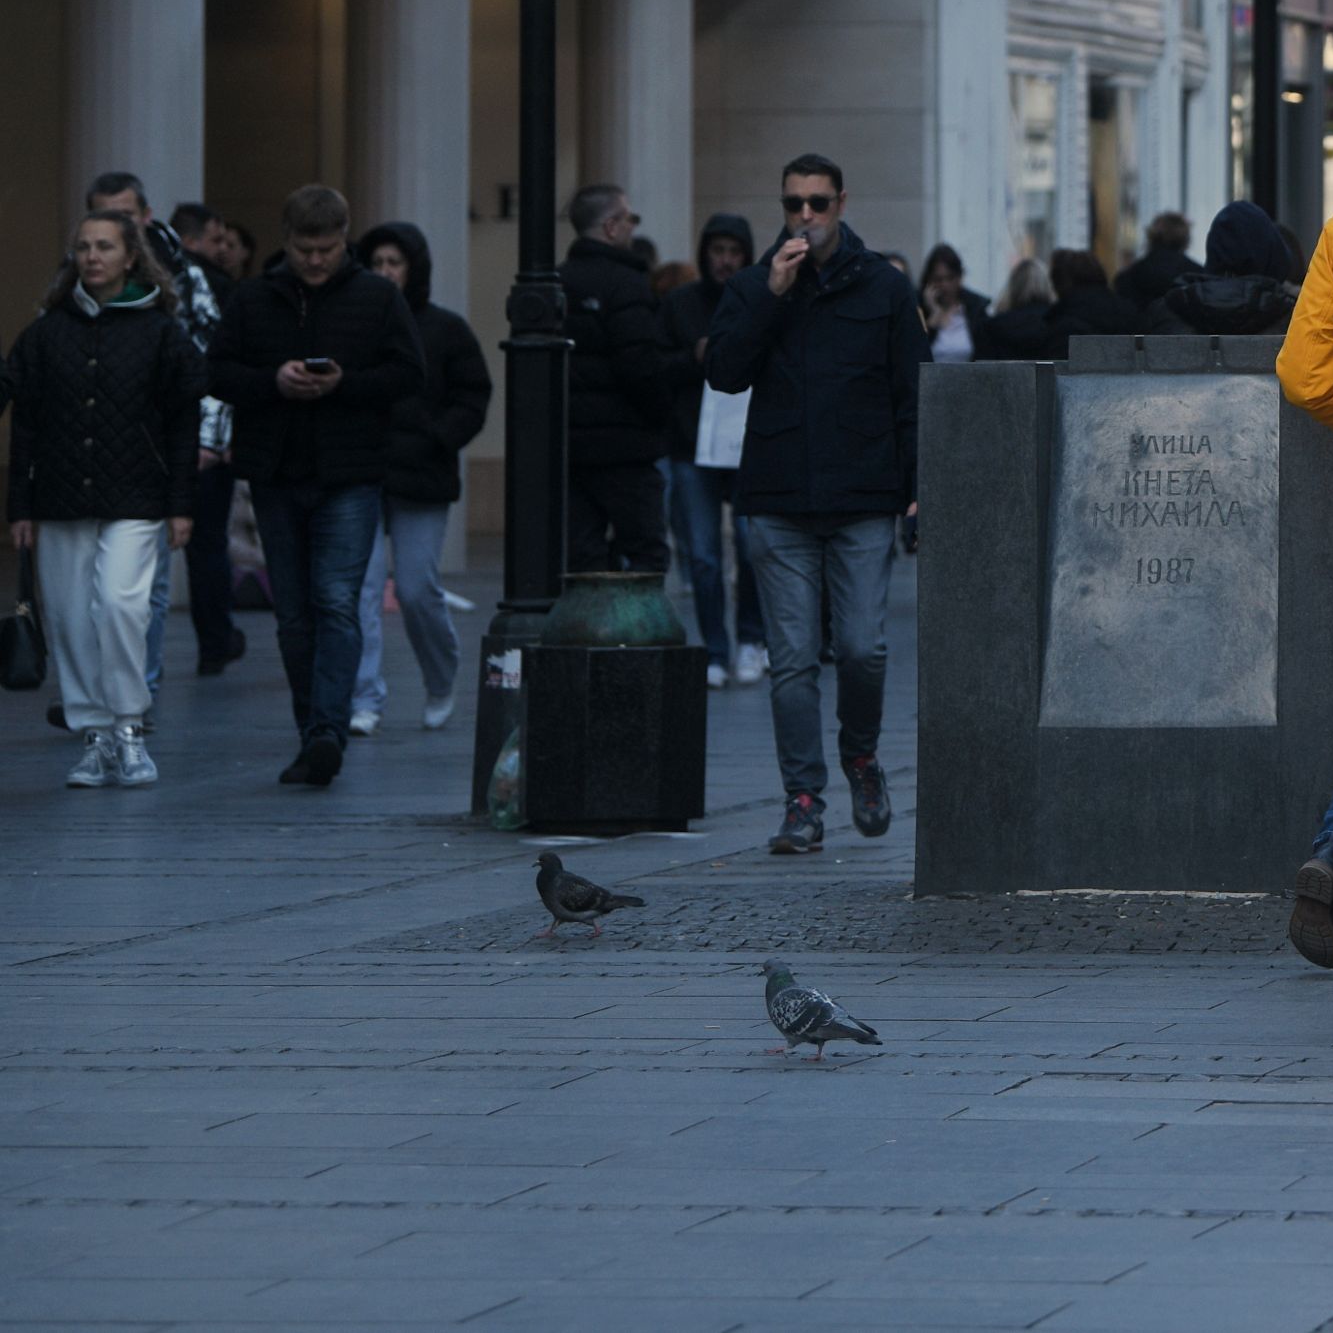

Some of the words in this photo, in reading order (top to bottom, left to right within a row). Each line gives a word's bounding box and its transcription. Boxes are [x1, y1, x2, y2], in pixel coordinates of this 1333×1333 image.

[1123, 469, 1217, 496] КНЕЗА
[1092, 500, 1246, 528] МИХАИЛА
[1136, 557, 1195, 585] 1987
